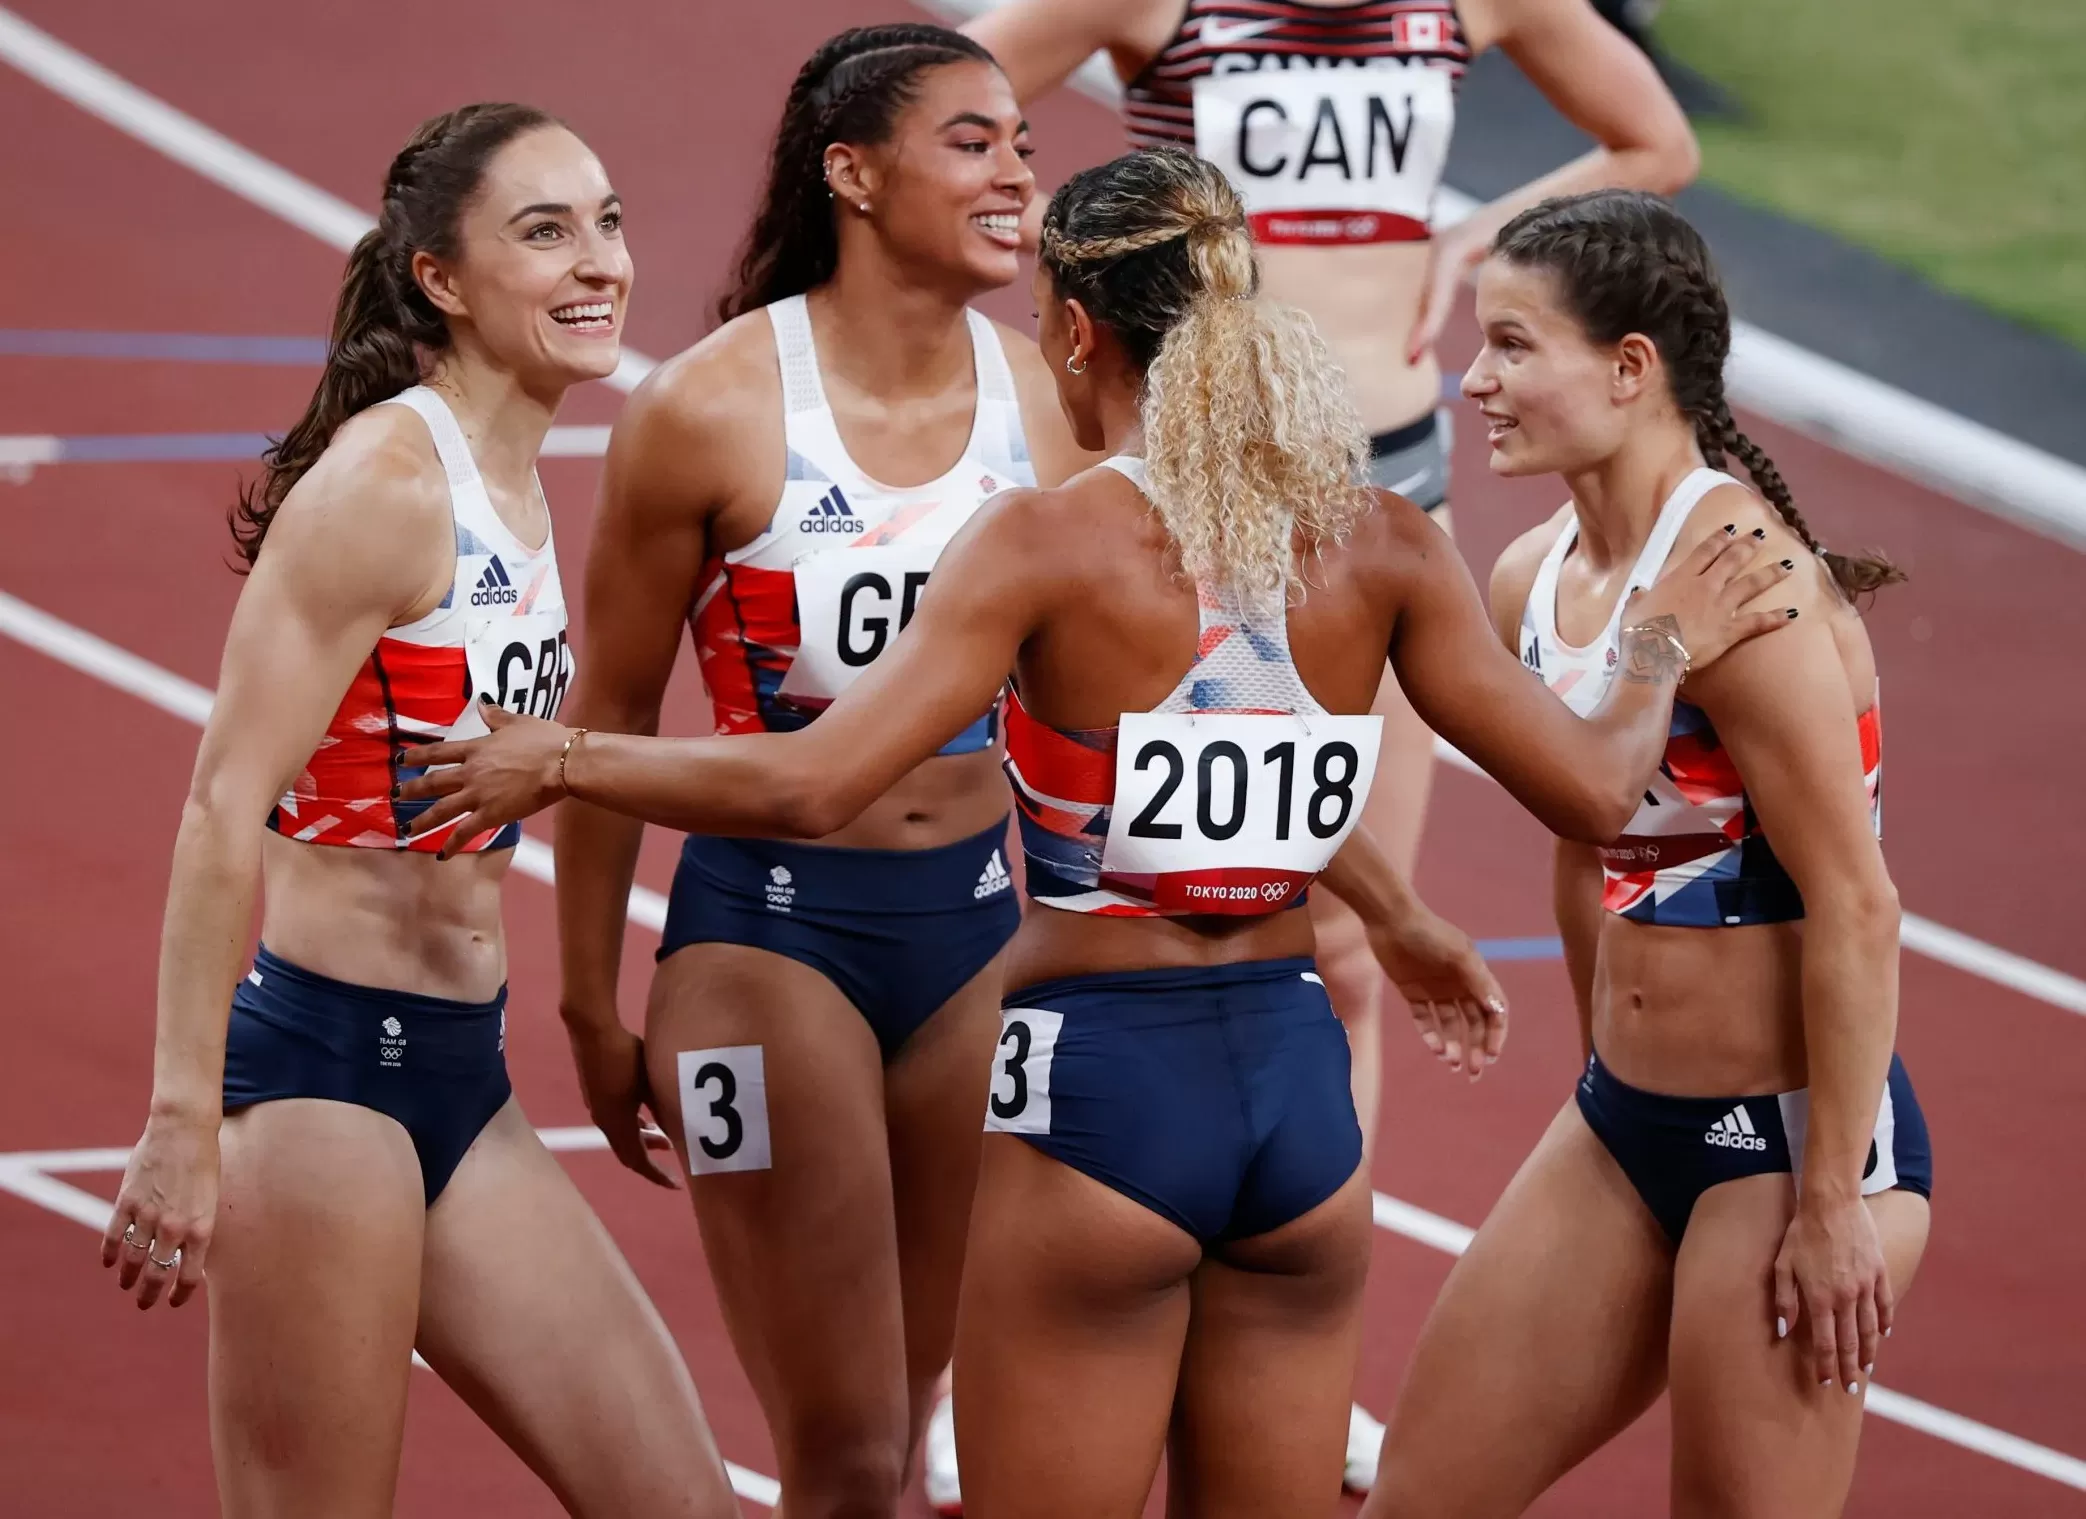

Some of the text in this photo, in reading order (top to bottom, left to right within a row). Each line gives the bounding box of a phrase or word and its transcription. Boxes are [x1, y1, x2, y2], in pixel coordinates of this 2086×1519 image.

[1238, 97, 1413, 180] CAN
[800, 515, 864, 533] adidas
[471, 586, 518, 606] adidas
[1128, 739, 1359, 841] 2018
[765, 884, 796, 895] TEAM GB
[1186, 884, 1258, 900] TOKYO 2020
[380, 1037, 407, 1046] TEAM GB
[990, 1020, 1032, 1119] 3
[694, 1061, 744, 1159] 3
[1704, 1129, 1767, 1151] adidas
